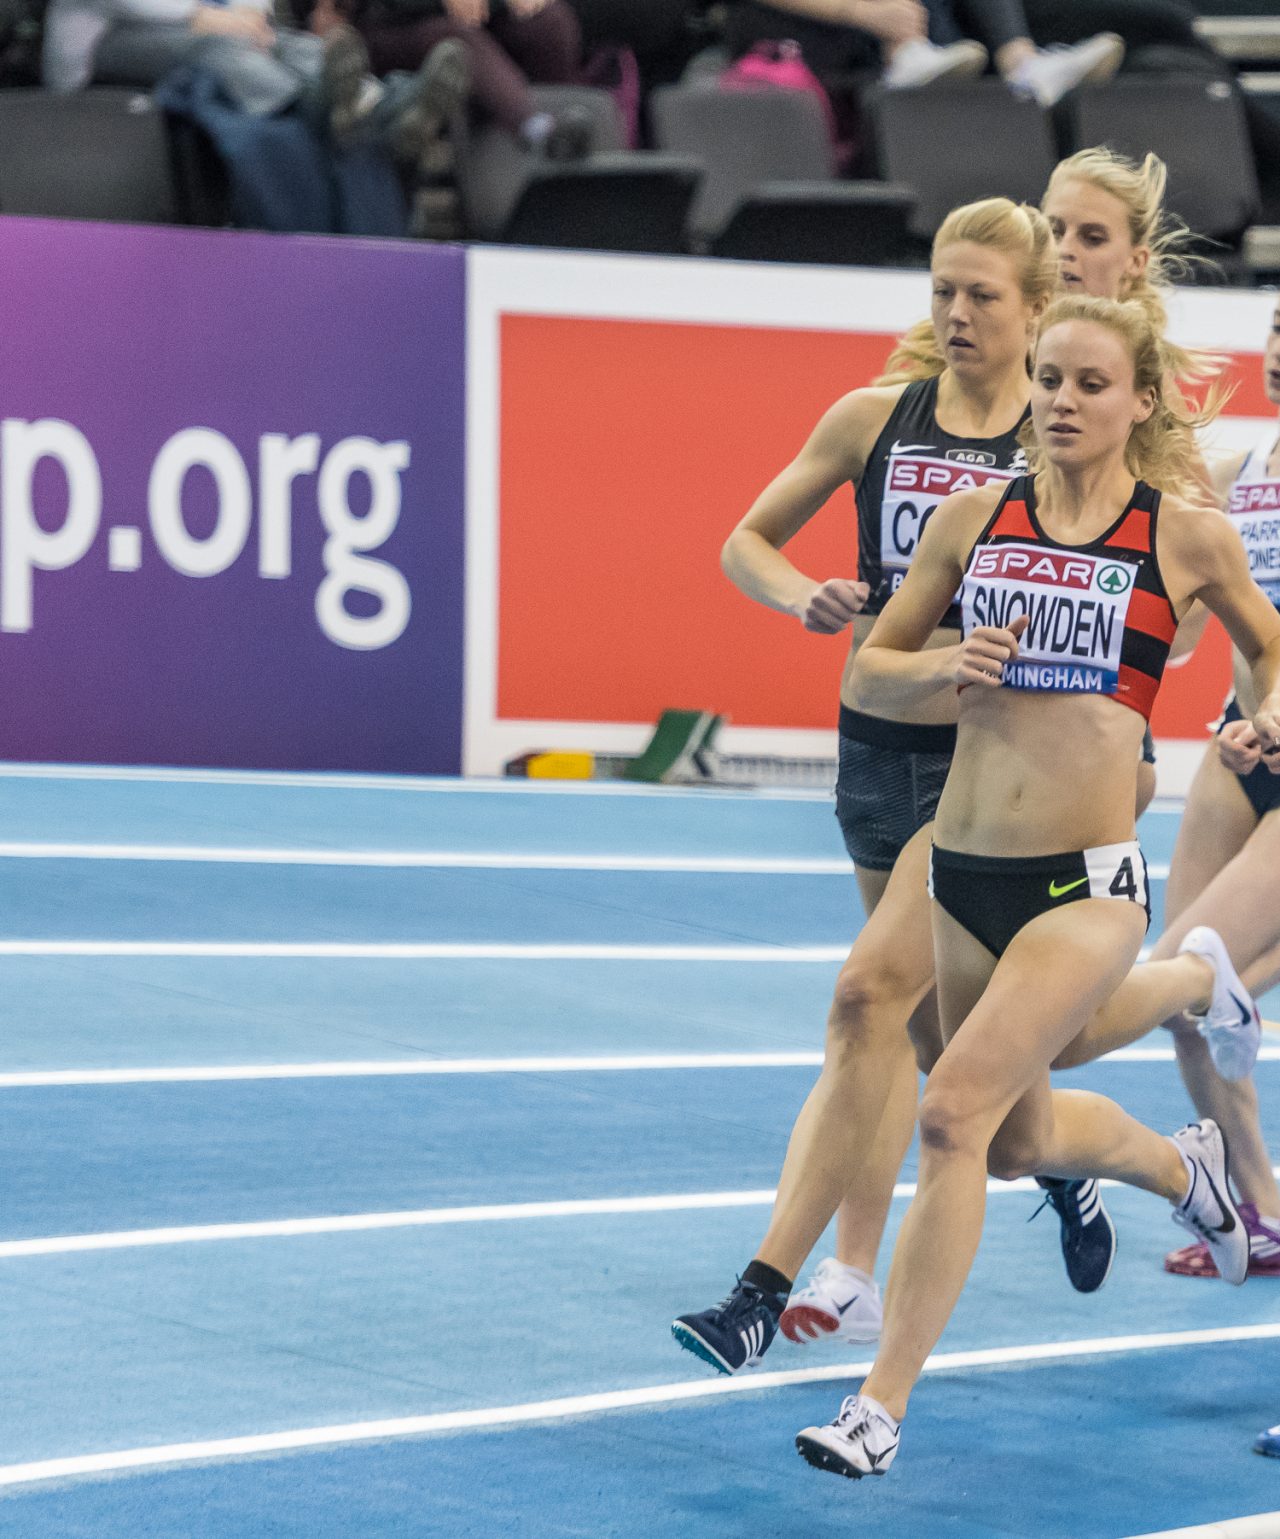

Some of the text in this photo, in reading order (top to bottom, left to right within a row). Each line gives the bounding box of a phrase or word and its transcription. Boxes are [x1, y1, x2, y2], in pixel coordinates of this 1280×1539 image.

[955, 452, 986, 464] AGA
[893, 464, 1010, 492] SPA
[0, 418, 412, 651] p.org
[975, 552, 1092, 585] SPAR
[973, 586, 1116, 659] SNOWDEN
[1001, 663, 1103, 690] MINGHAM
[1109, 856, 1138, 902] 4
